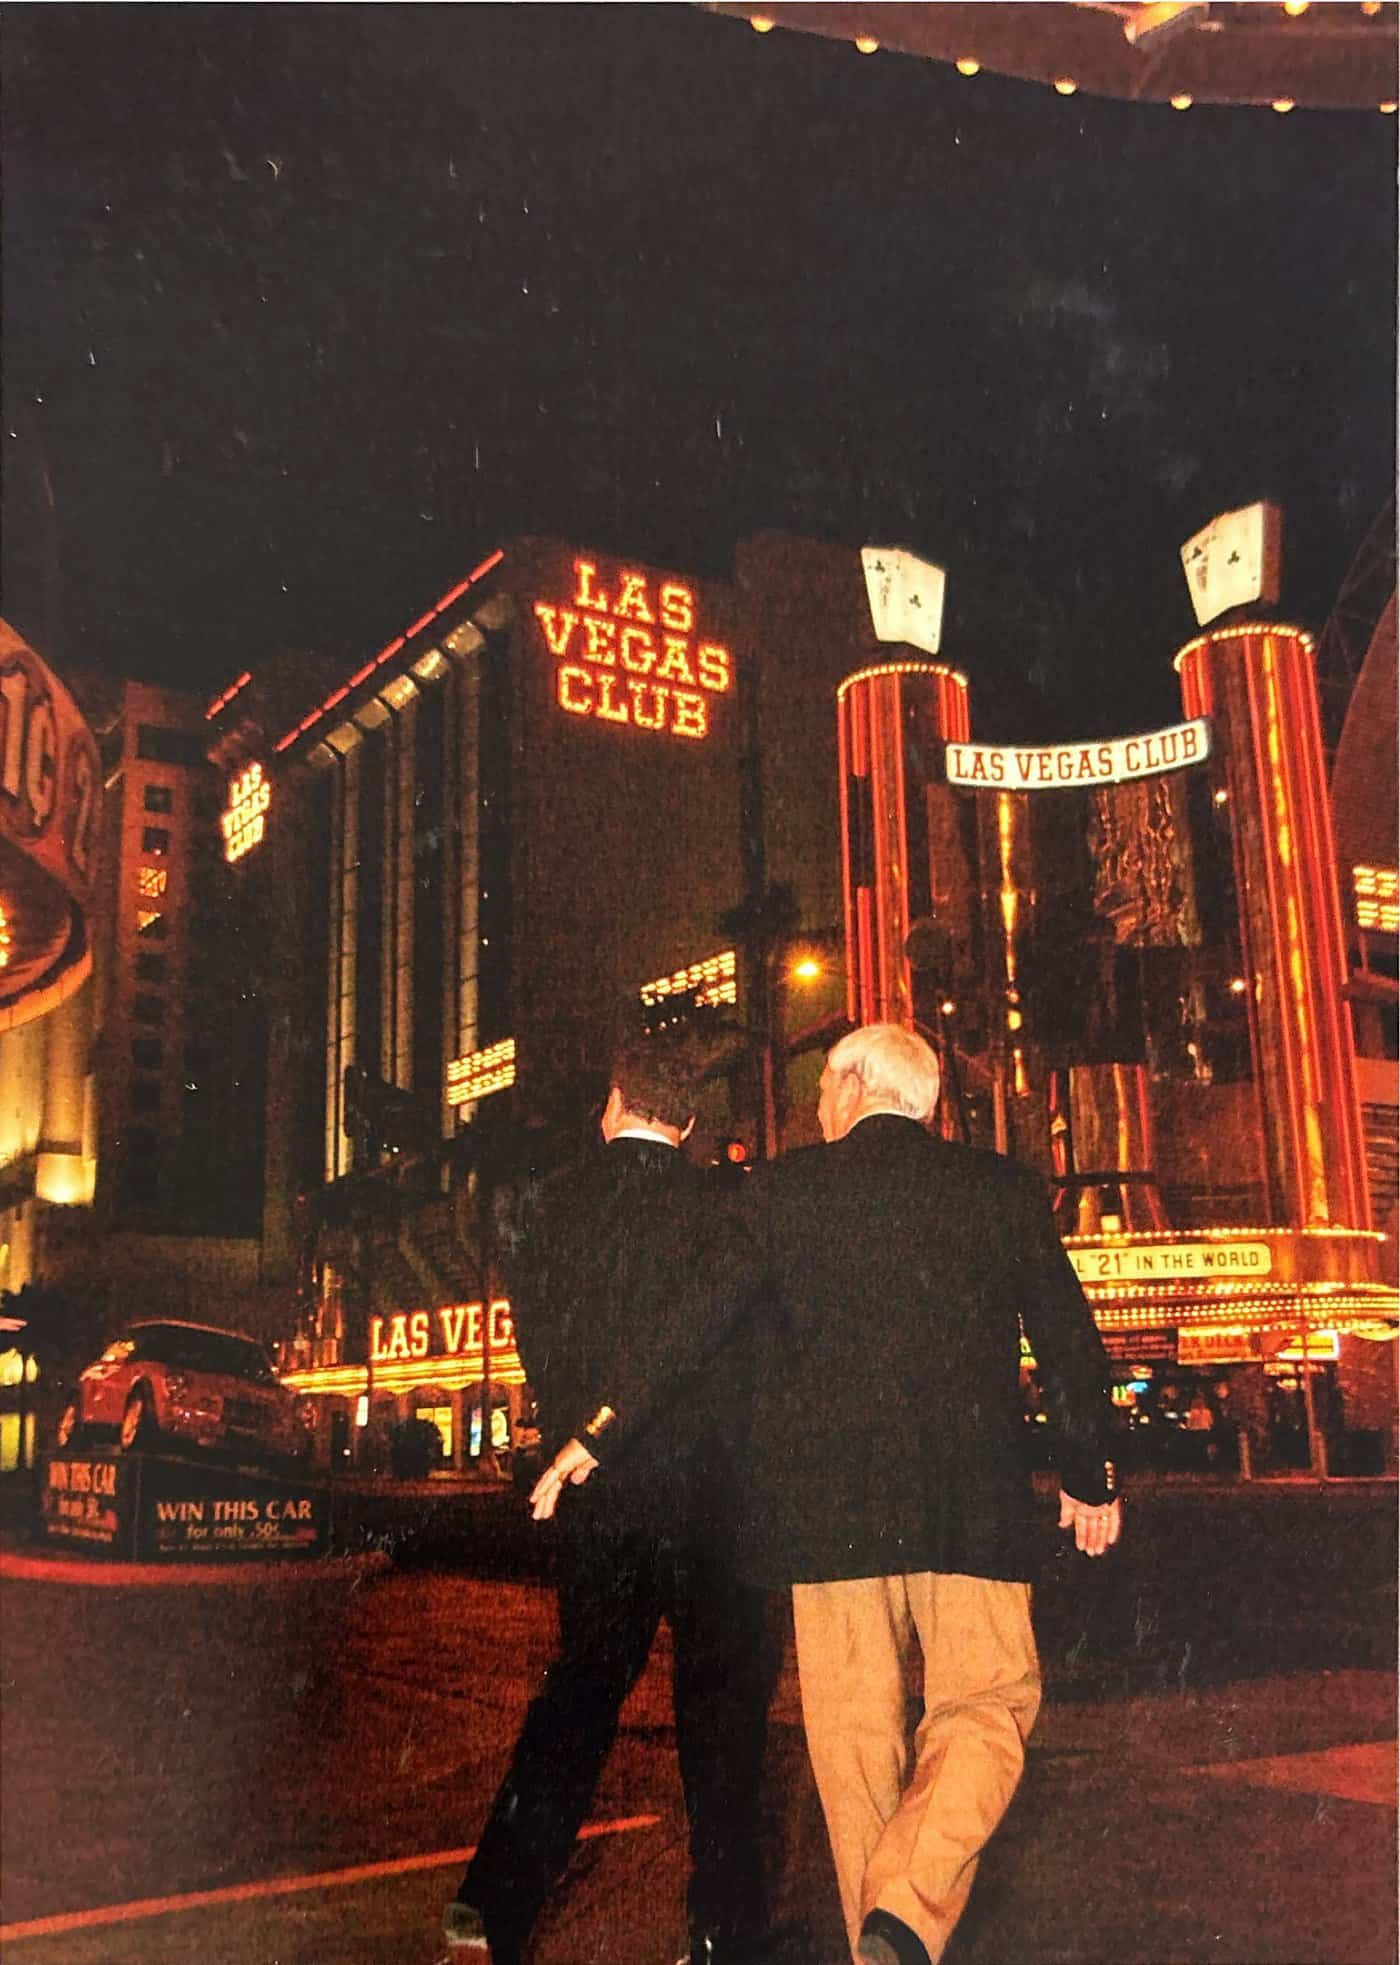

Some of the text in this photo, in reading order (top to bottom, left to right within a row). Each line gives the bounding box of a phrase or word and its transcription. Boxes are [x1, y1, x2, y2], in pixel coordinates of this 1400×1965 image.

[574, 560, 694, 632] LAS
[534, 602, 731, 692] VEGAS
[558, 666, 707, 738] CLUB
[953, 727, 1198, 781] LAS VEGAS CLUB
[1136, 1255, 1153, 1270] IN
[1160, 1253, 1193, 1269] THE
[1201, 1250, 1260, 1268] WORLD
[370, 1298, 516, 1361] LAS VEG
[156, 1499, 312, 1521] WIN THIS CAR
